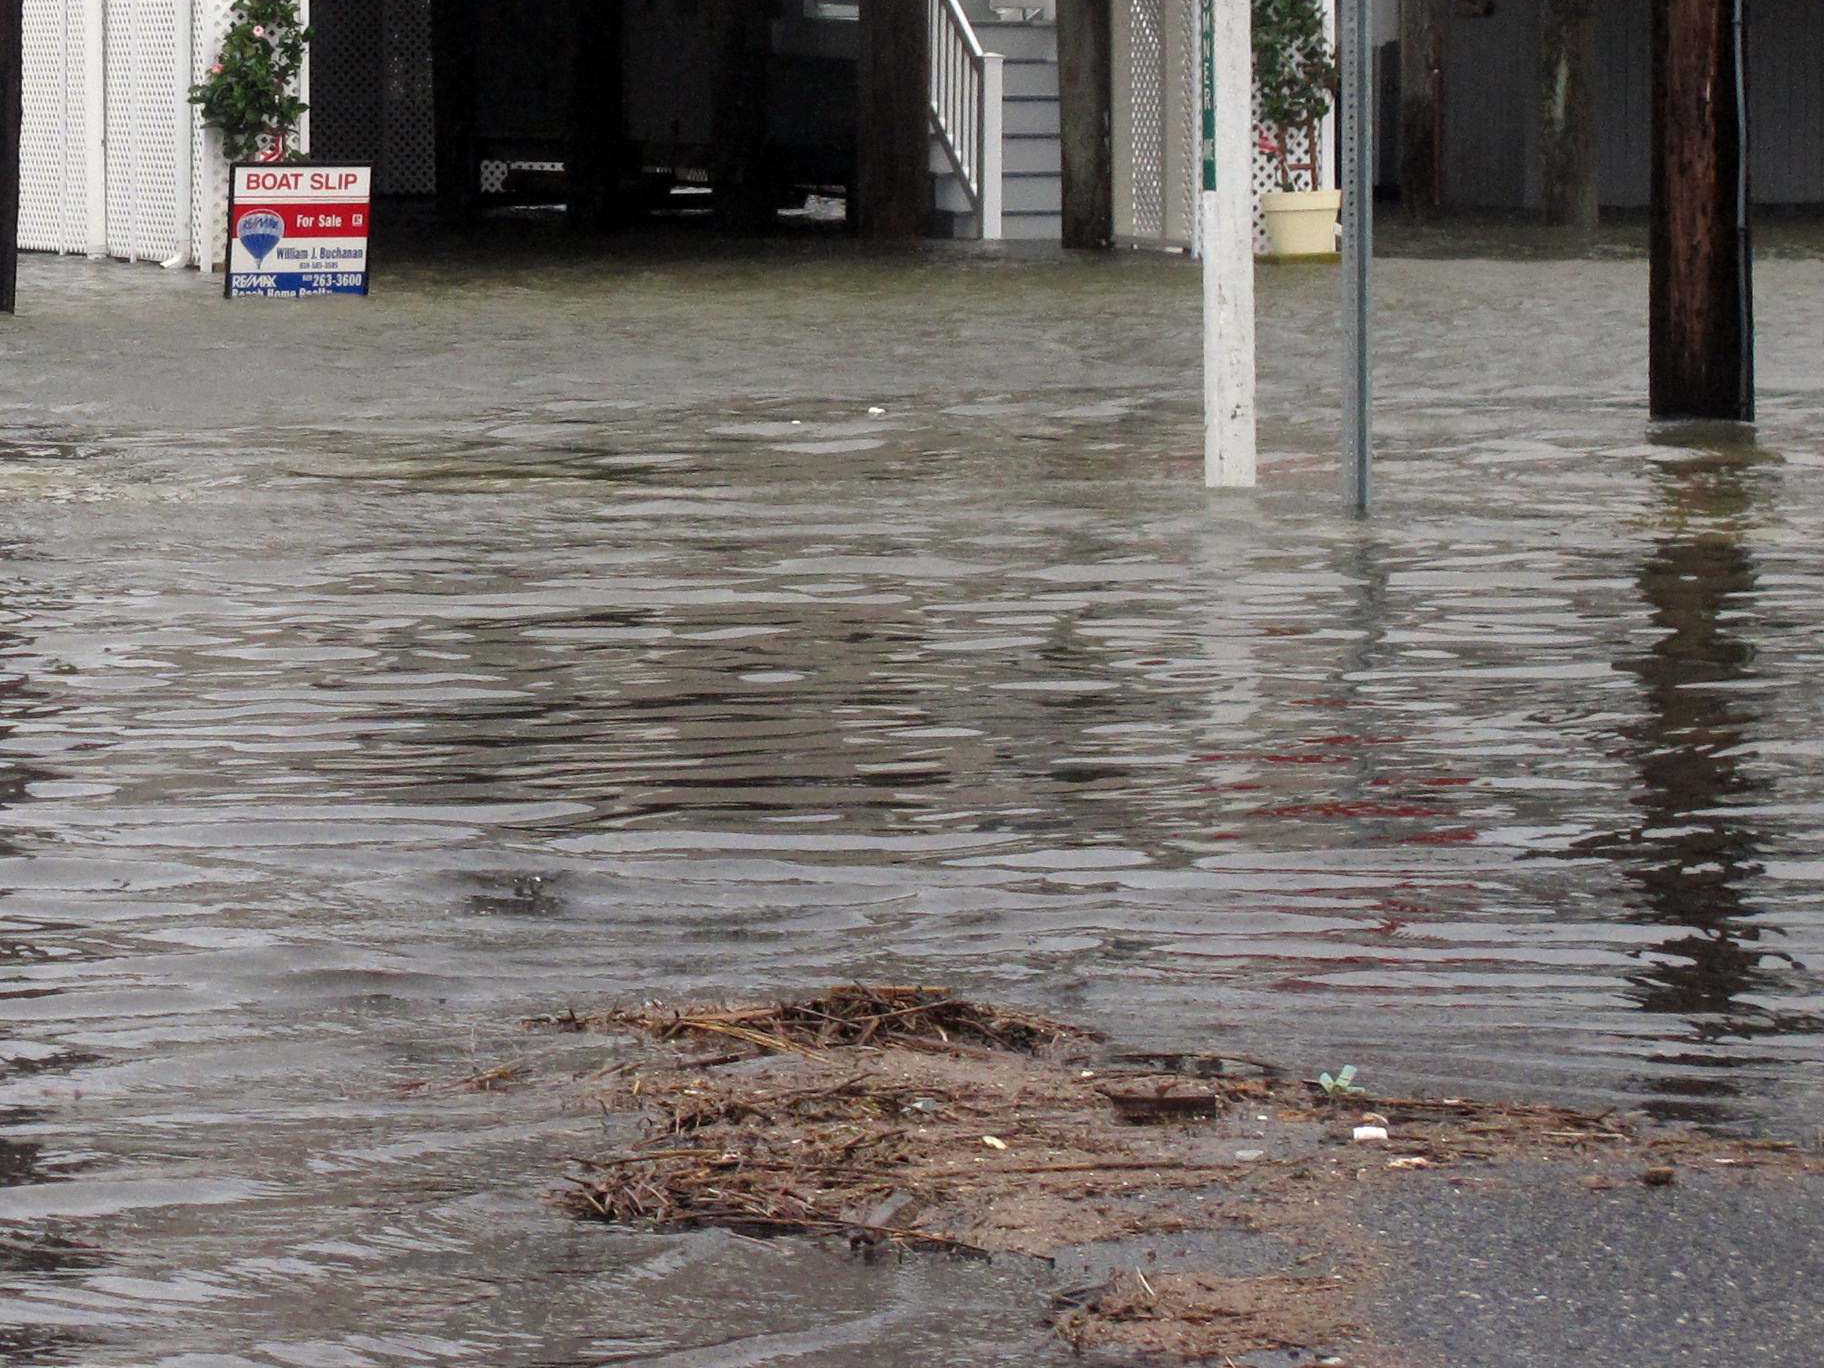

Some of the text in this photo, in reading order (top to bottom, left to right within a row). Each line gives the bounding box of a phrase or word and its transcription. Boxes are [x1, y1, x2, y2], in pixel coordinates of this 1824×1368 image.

[246, 173, 358, 191] BOAT SLIP
[296, 214, 315, 228] For
[318, 214, 342, 228] Sale
[277, 247, 308, 259] William
[319, 246, 363, 259] Buchanan
[232, 274, 277, 288] RE/MAX
[312, 273, 362, 287] 263-3600
